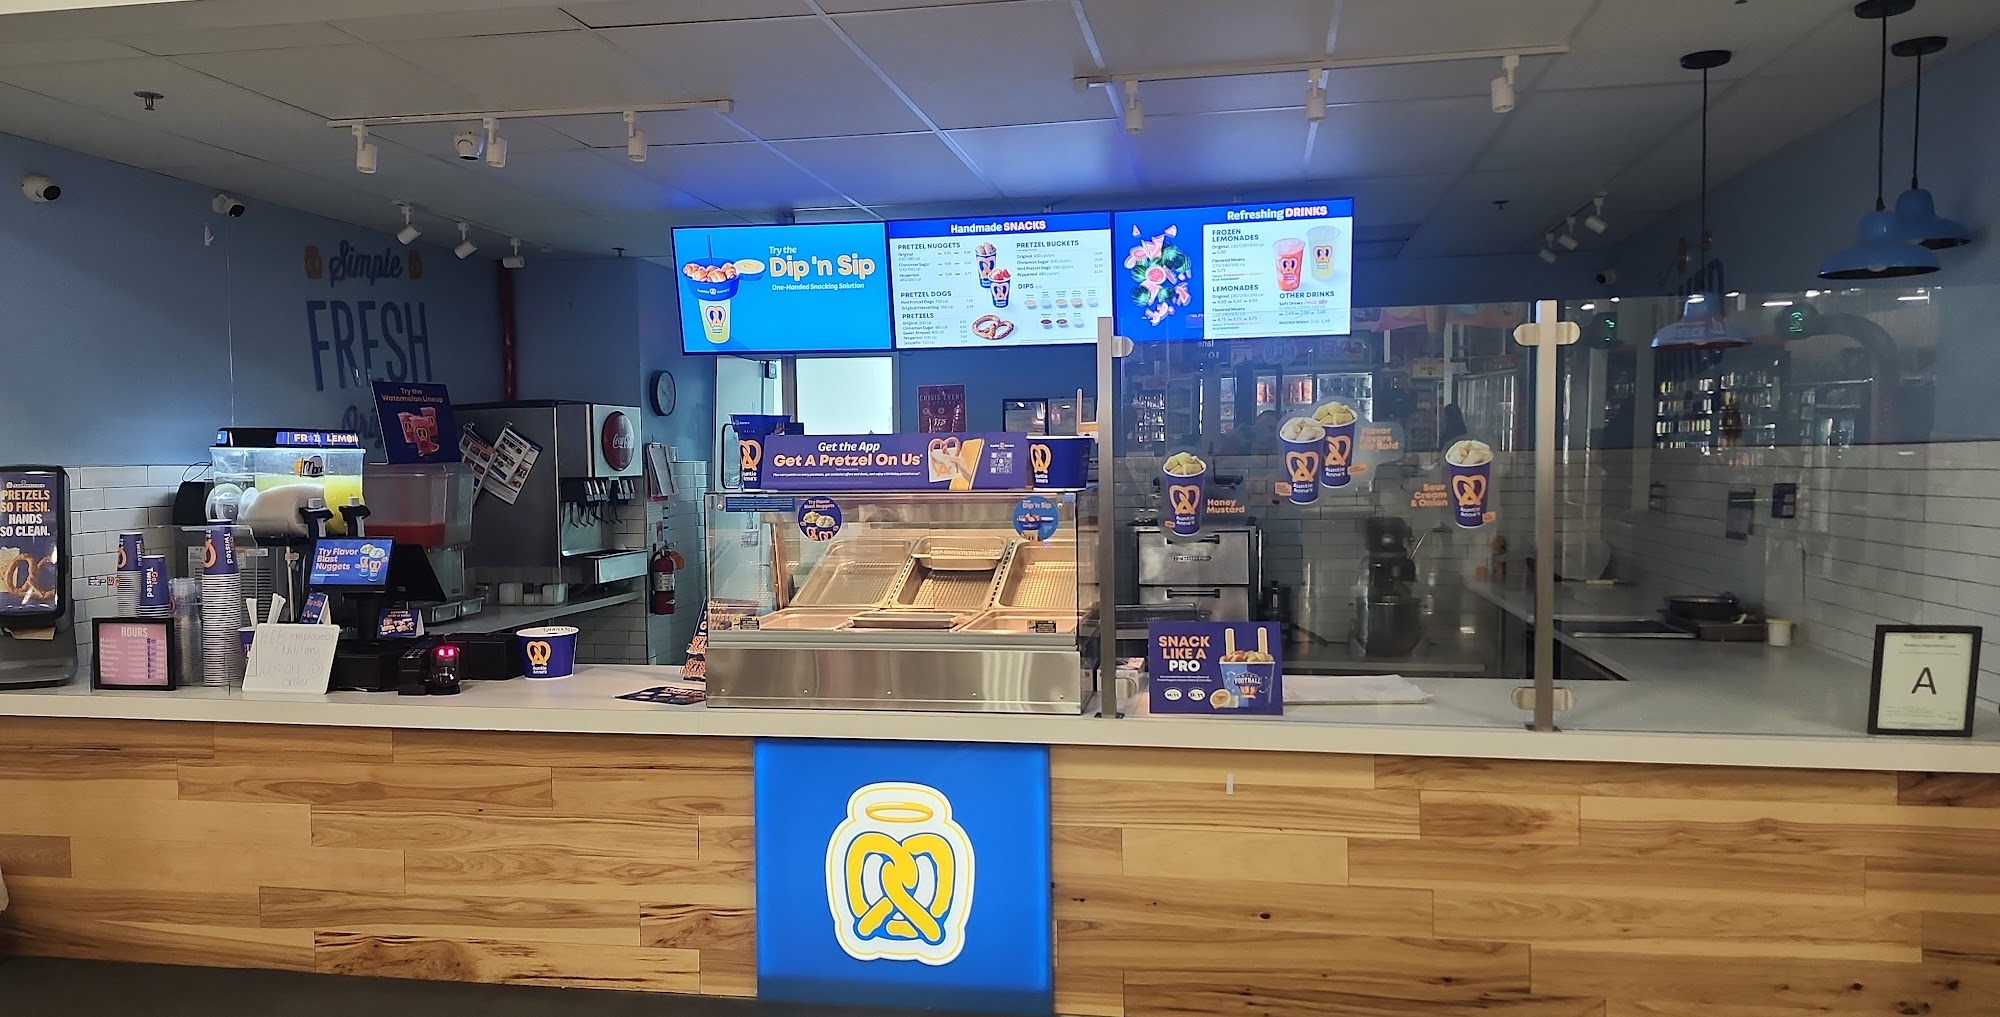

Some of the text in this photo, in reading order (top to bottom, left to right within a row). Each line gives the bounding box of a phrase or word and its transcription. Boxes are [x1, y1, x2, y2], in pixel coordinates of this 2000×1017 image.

[1227, 206, 1328, 221] Refreshing DRINKS
[950, 220, 1047, 234] Handmade SNACKS
[1212, 228, 1241, 236] FROZEN
[1212, 234, 1259, 242] LEMONADES
[768, 246, 797, 255] Try the
[328, 239, 404, 288] Simple
[769, 253, 876, 281] Dip 'n Sip
[810, 283, 838, 291] Snacking
[838, 282, 865, 290] Solution
[1212, 284, 1259, 292] LEMONADES
[1306, 290, 1335, 298] DRINKS
[305, 300, 432, 392] FRESH
[400, 387, 423, 395] Try the
[381, 394, 423, 403] Watermelon
[818, 441, 880, 454] Get the App
[774, 454, 802, 468] Get
[804, 454, 816, 467] A
[820, 453, 873, 467] Pretzel
[875, 453, 898, 466] On
[1422, 483, 1446, 491] Sour
[1, 490, 50, 501] PRETZELS
[0, 501, 51, 513] SO FRESH.
[1022, 502, 1034, 510] Dip
[1040, 501, 1052, 510] Sip
[1418, 499, 1448, 507] Onion
[1206, 506, 1245, 514] Mustard
[8, 513, 43, 525] HANDS
[0, 525, 51, 537] SO CLEAN.
[223, 532, 234, 565] Twisted
[318, 547, 359, 556] Try Flavor
[316, 555, 338, 563] Blast
[315, 563, 351, 572] Nuggets
[146, 566, 154, 598] Twisted
[151, 571, 159, 585] Get
[121, 626, 148, 638] HOURS
[1158, 635, 1210, 648] SNACK
[1162, 648, 1207, 660] LIKE A
[1168, 659, 1201, 672] PRO
[1911, 666, 1937, 695] A
